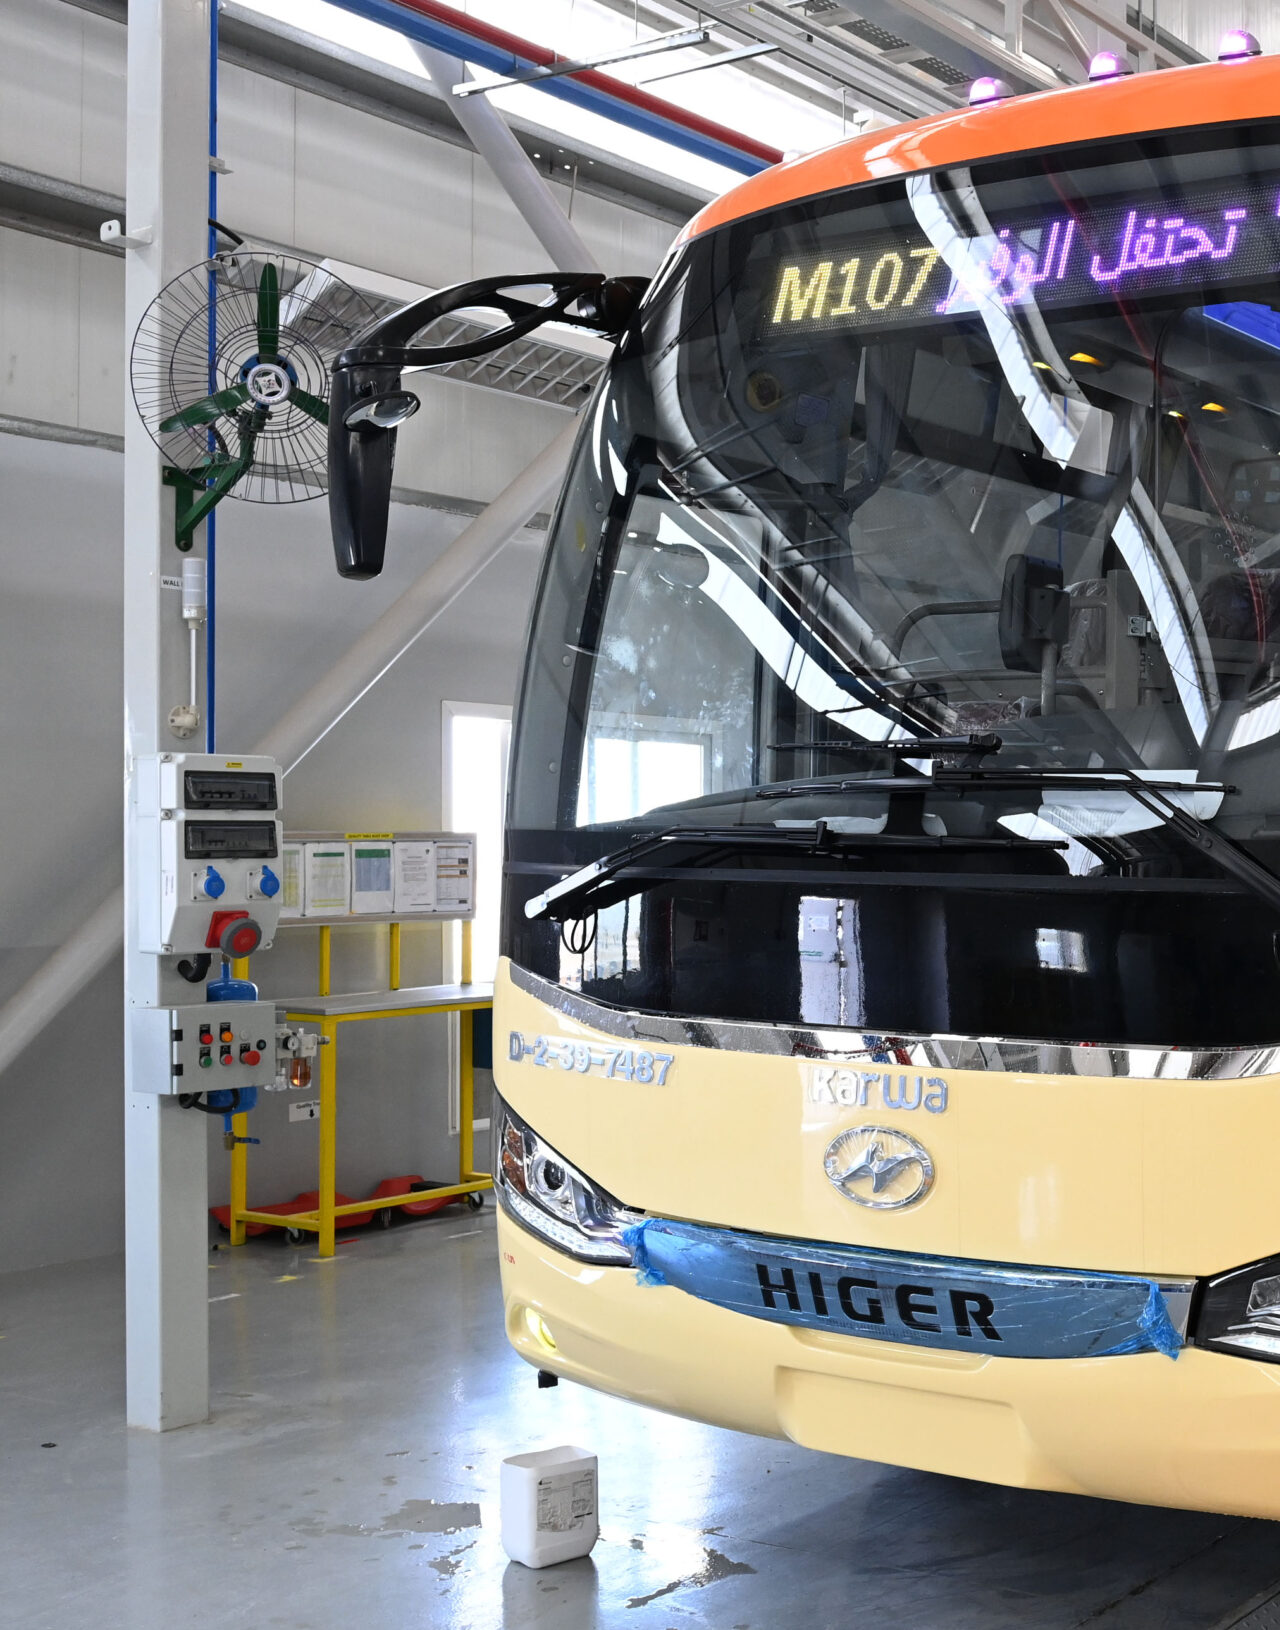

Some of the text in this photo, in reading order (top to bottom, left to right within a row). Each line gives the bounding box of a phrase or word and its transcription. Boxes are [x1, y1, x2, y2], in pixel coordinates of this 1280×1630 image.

[1089, 209, 1247, 282] تحتفل
[772, 246, 943, 324] M107
[162, 579, 180, 587] WALL
[508, 1030, 675, 1086] D-2-39-7487
[755, 1263, 1004, 1342] HIGER
